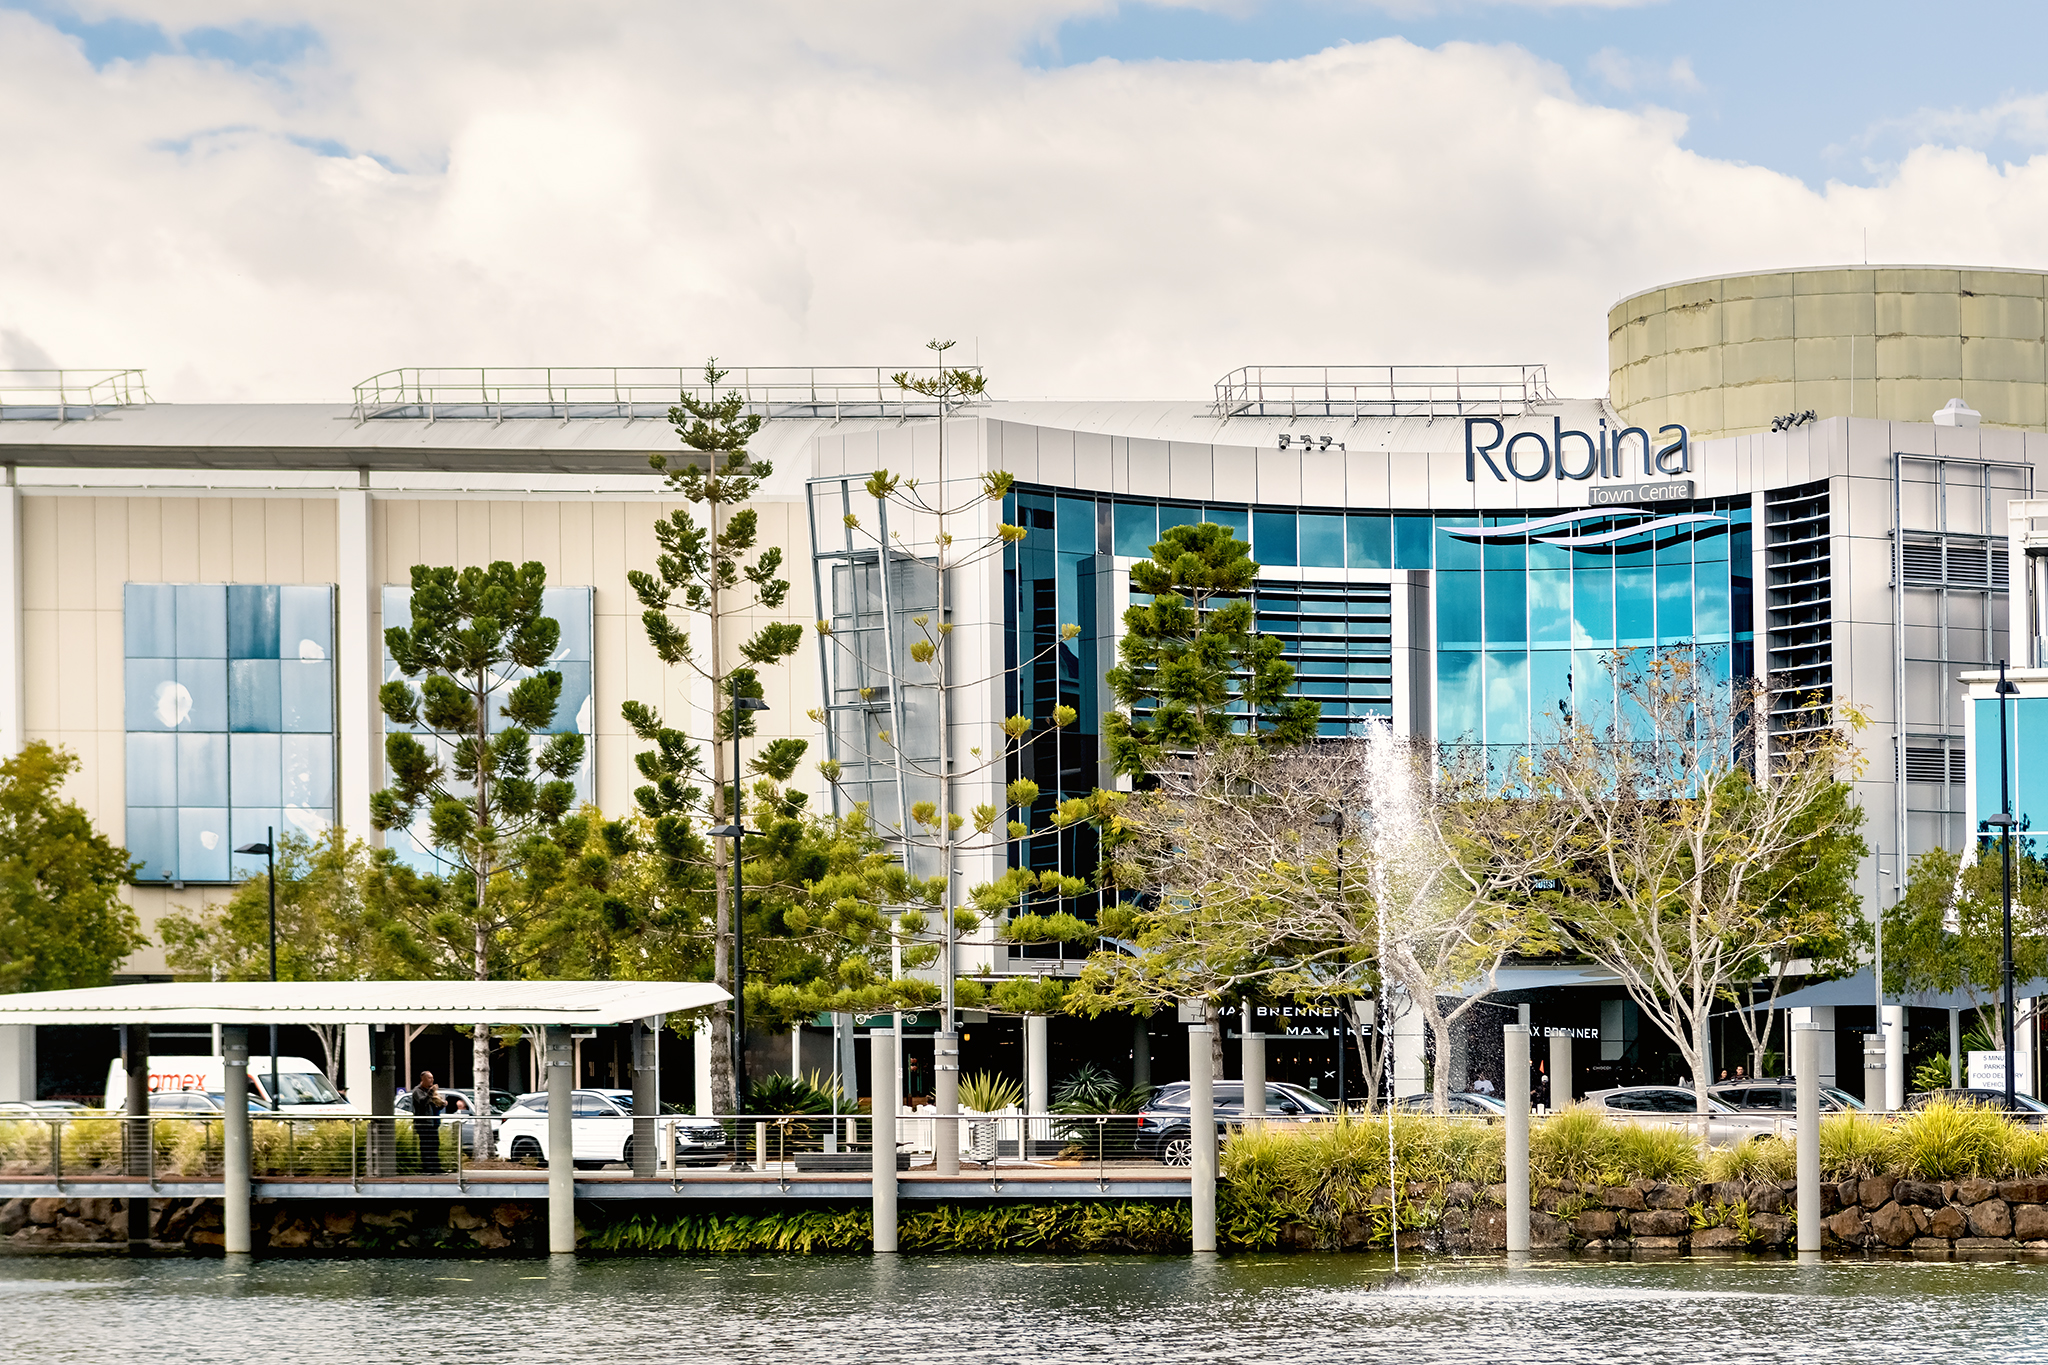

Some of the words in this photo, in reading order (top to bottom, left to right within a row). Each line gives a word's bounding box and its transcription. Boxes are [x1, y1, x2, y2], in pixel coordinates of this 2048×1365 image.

[1464, 416, 1692, 482] Robina
[1590, 486, 1634, 504] Town
[1638, 483, 1688, 501] Centre
[1286, 1026, 1325, 1036] MAX
